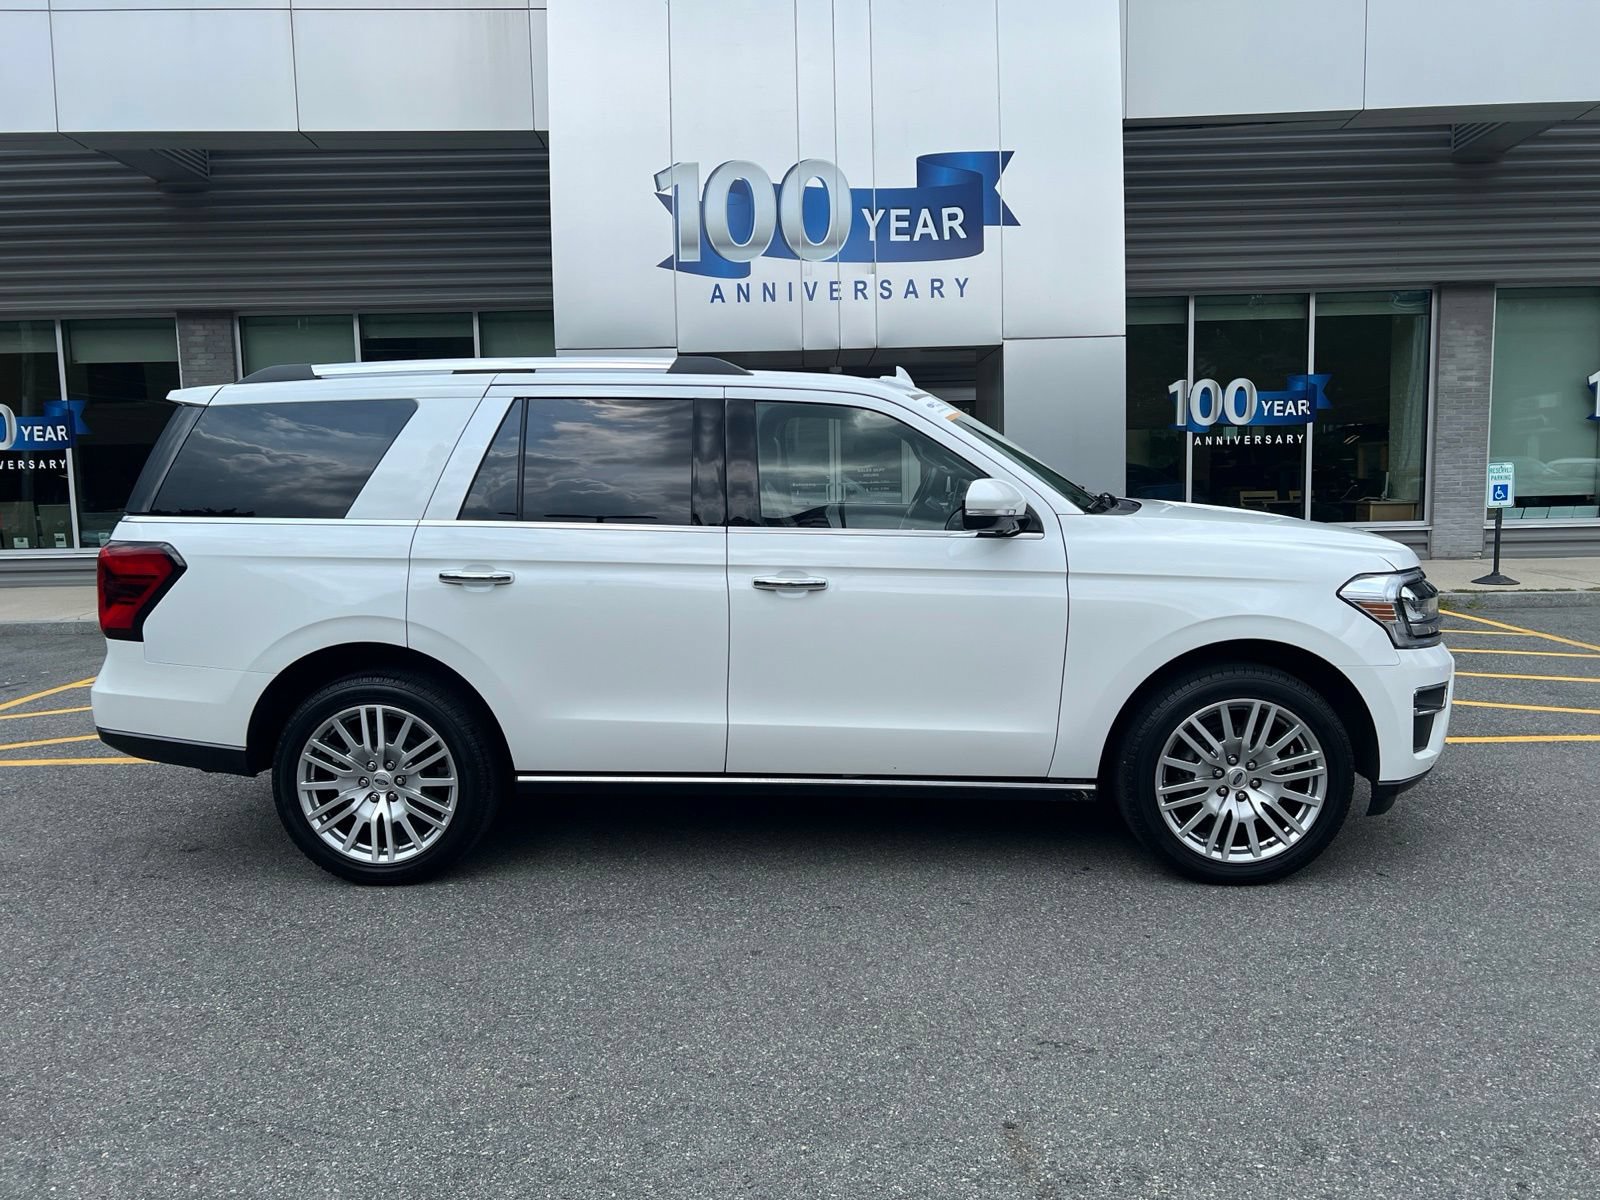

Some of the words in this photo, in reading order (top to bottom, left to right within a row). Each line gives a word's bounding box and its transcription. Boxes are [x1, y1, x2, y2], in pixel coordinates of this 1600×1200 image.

[654, 158, 852, 263] 100
[861, 206, 967, 242] YEAR
[710, 277, 969, 303] ANNIVERSARY
[1168, 378, 1258, 426] 100
[1261, 399, 1311, 417] YEAR
[20, 425, 68, 441] YEAR
[1194, 434, 1304, 446] ANNIVERSARY
